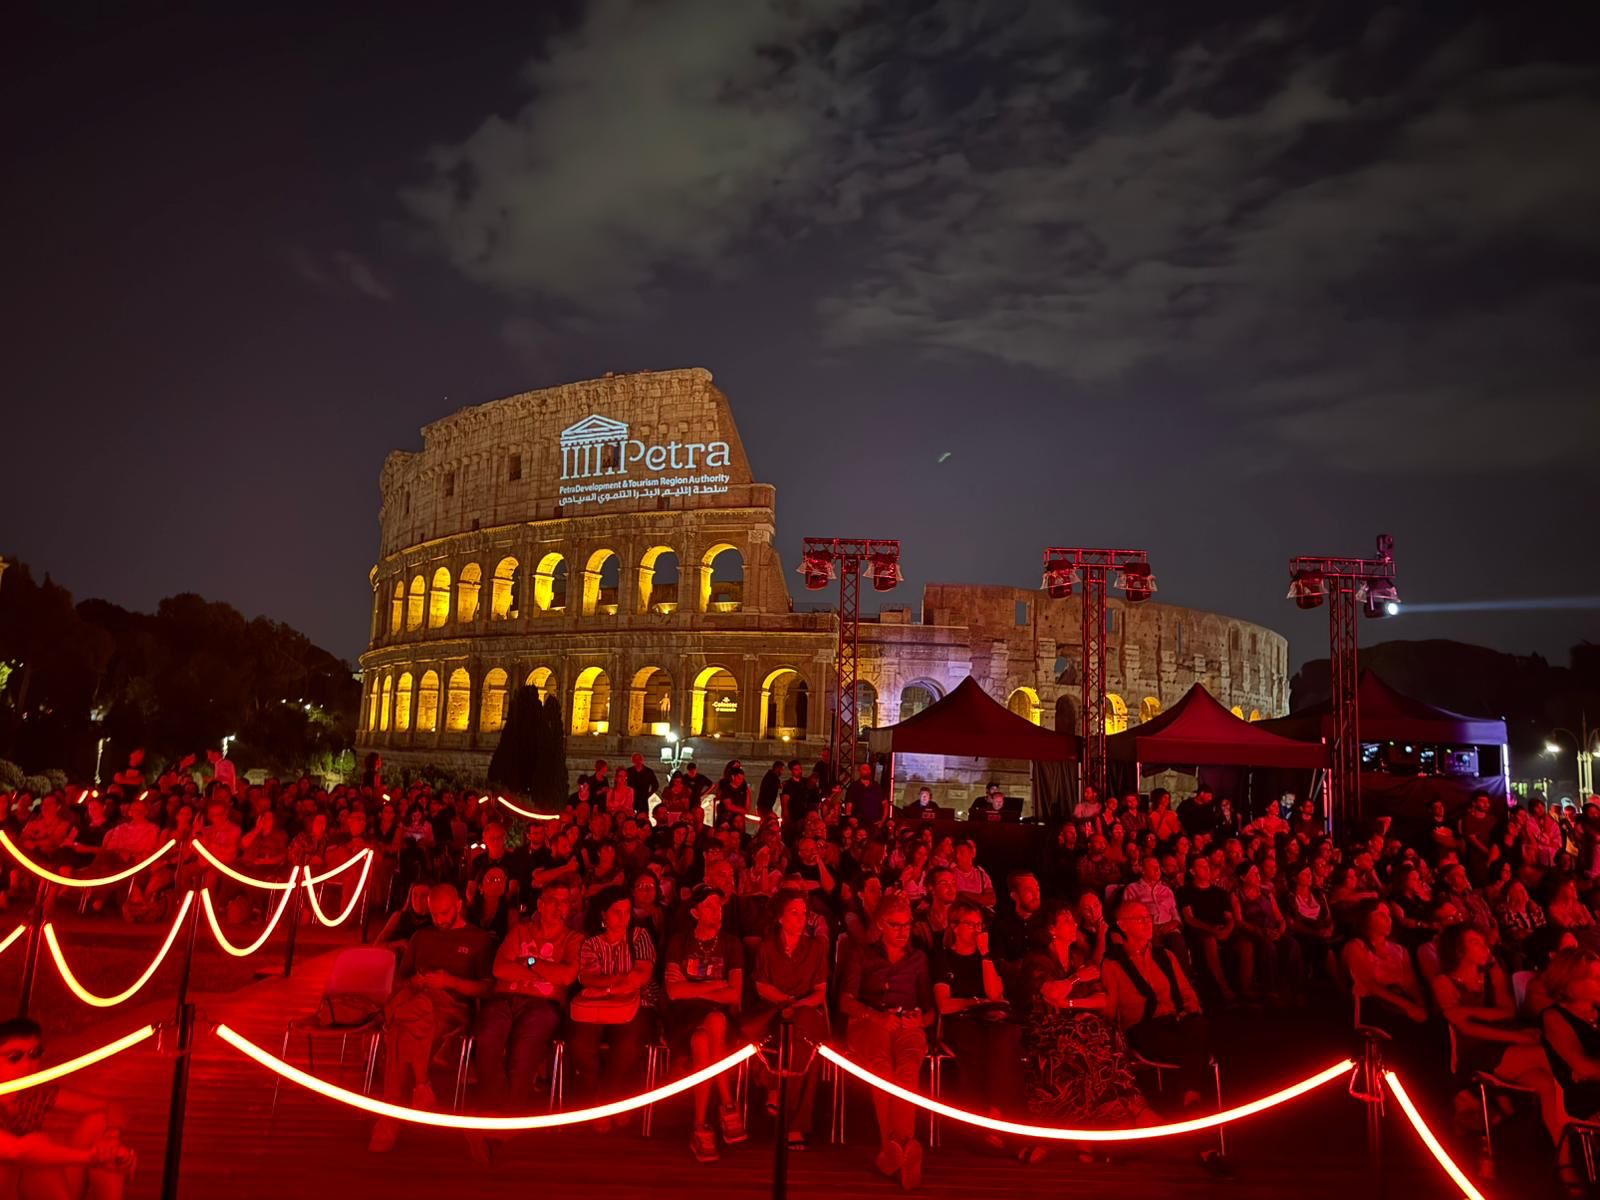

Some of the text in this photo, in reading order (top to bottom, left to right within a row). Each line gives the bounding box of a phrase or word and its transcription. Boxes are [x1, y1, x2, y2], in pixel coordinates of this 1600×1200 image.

[618, 440, 730, 473] Petra
[559, 473, 730, 494] Petra Development & Tourism Region Authority
